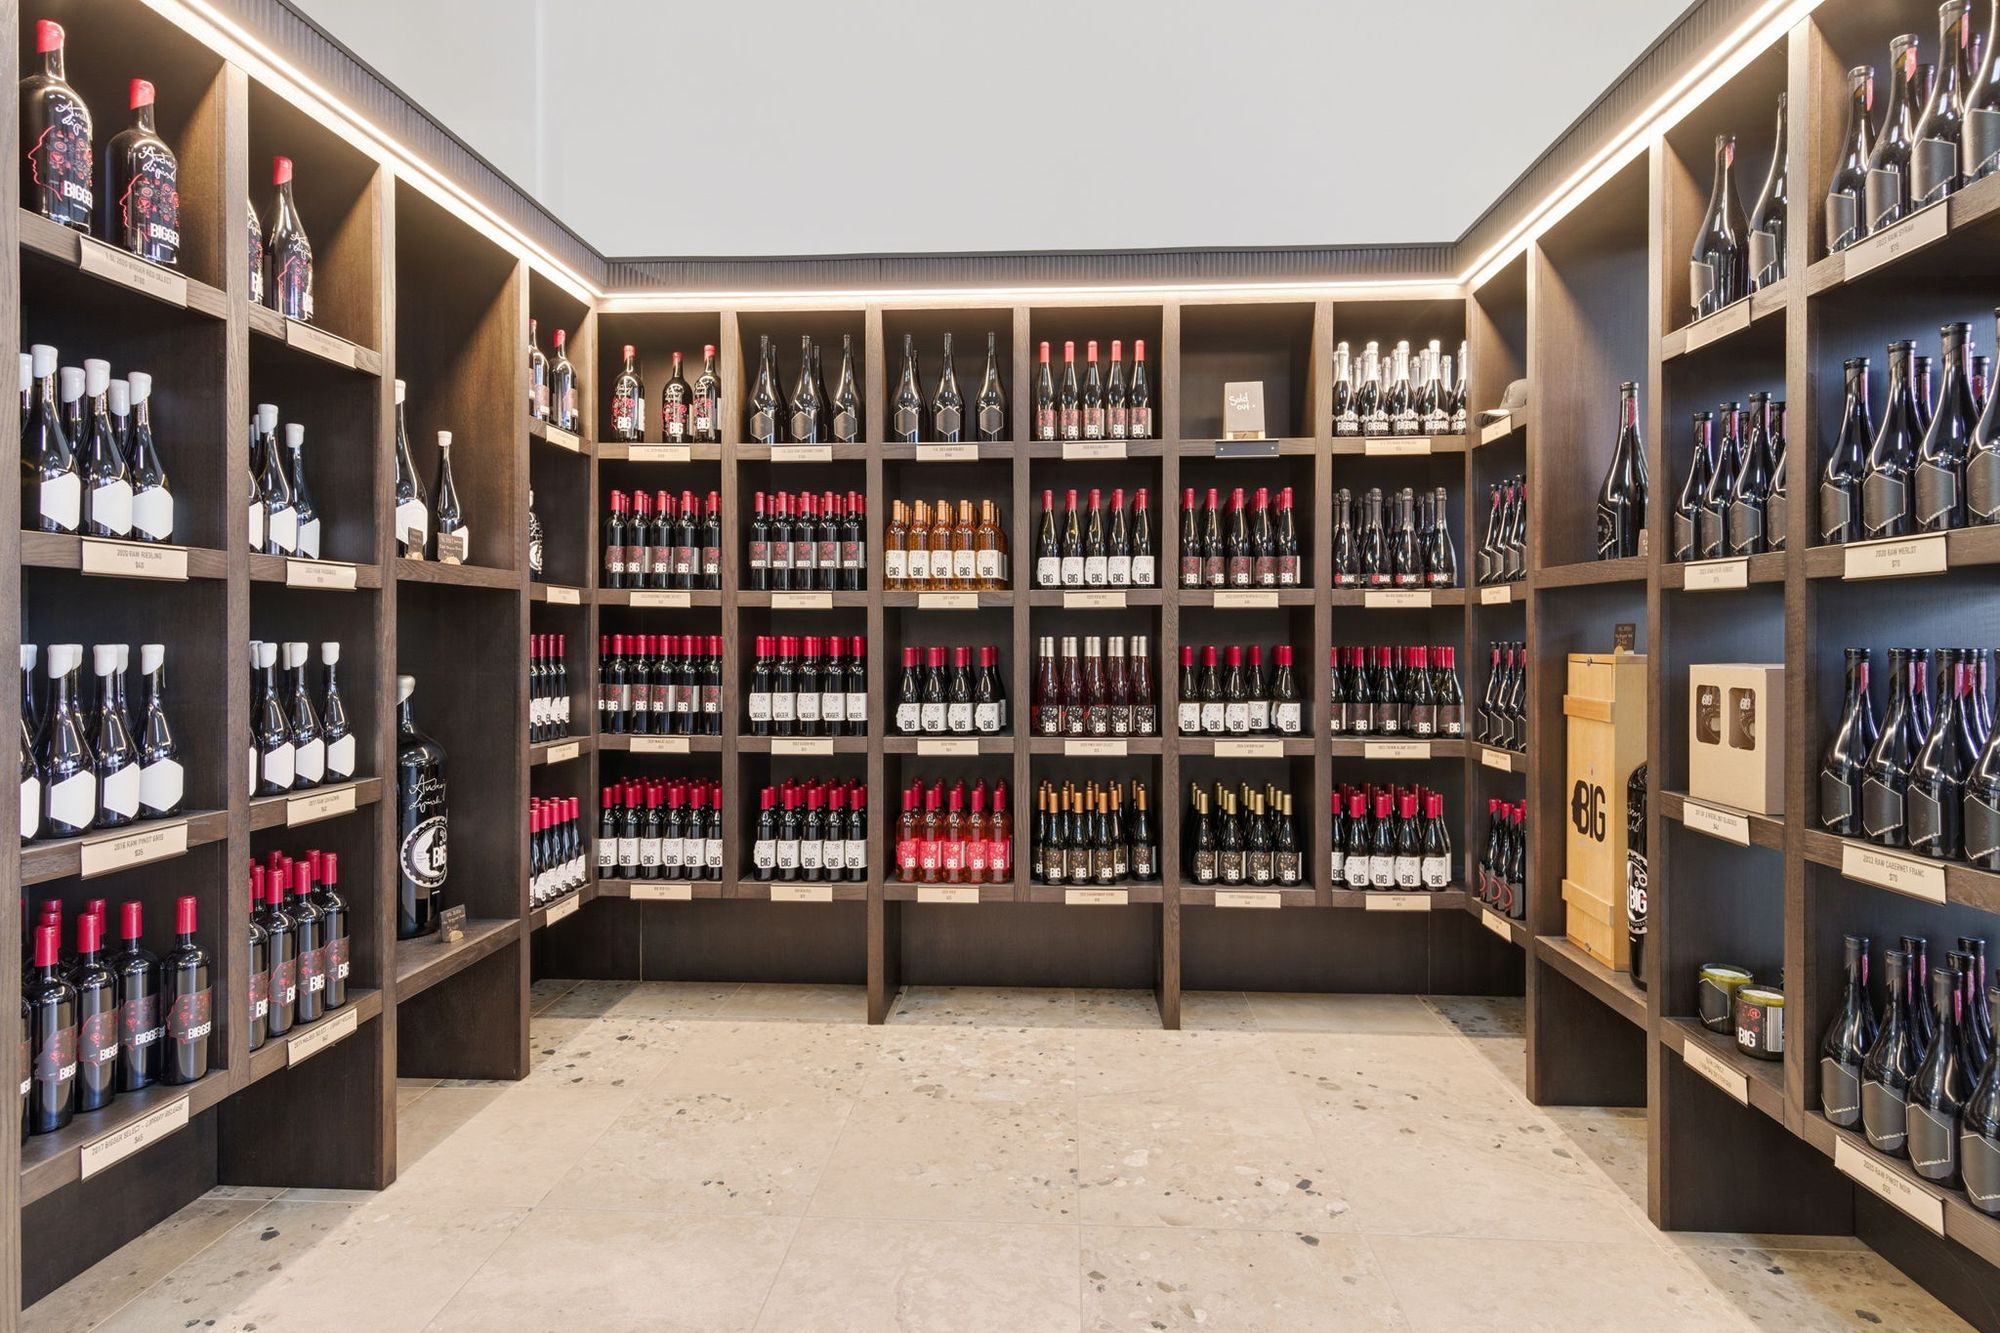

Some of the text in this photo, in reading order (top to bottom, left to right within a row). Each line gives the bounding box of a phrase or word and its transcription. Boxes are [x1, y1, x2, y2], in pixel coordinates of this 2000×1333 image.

[1229, 392, 1248, 406] Sold
[617, 417, 631, 429] BIG
[670, 422, 683, 434] BIG
[697, 417, 709, 429] BIG
[1044, 427, 1054, 436] BIG
[1068, 426, 1078, 436] BIG
[1088, 425, 1098, 435] BIG
[1113, 425, 1124, 435] BIG
[1133, 424, 1143, 434] BIG
[613, 563, 623, 572] BIG
[629, 563, 640, 572] BIG
[656, 563, 666, 572] BIG
[678, 563, 688, 572] BIG
[707, 564, 717, 573] BIG
[889, 567, 899, 576] BIG
[913, 567, 923, 576] BIG
[937, 567, 946, 576] BIG
[960, 567, 970, 576] BIG
[983, 567, 993, 576] BIG
[1043, 574, 1053, 583] BIG
[1068, 574, 1078, 583] BIG
[1092, 573, 1102, 582] BIG
[1113, 573, 1123, 582] BIG
[1139, 573, 1150, 582] BIG
[1186, 574, 1197, 583] BIG
[1215, 574, 1224, 583] BIG
[1237, 573, 1248, 583] BIG
[1264, 573, 1274, 584] BIG
[1281, 573, 1292, 582] BIG
[608, 701, 617, 710] BIG
[636, 700, 647, 710] BIG
[654, 702, 663, 711] BIG
[678, 702, 688, 711] BIG
[706, 702, 716, 711] BIG
[905, 720, 915, 729] BIG
[928, 720, 938, 729] BIG
[955, 720, 965, 729] BIG
[983, 720, 993, 729] BIG
[1046, 722, 1056, 732] BIG
[1072, 722, 1082, 732] BIG
[1096, 722, 1106, 732] BIG
[1116, 722, 1126, 732] BIG
[1142, 722, 1152, 732] BIG
[1184, 720, 1194, 730] BIG
[1210, 720, 1220, 730] BIG
[1233, 720, 1243, 730] BIG
[1251, 718, 1262, 727] BIG
[1286, 720, 1296, 730] BIG
[1356, 720, 1367, 730] BIG
[1386, 720, 1396, 730] BIG
[1419, 722, 1430, 732] BIG
[1450, 723, 1460, 732] BIG
[1572, 780, 1606, 842] BIG
[600, 855, 611, 865] BIG
[621, 855, 630, 864] BIG
[644, 855, 654, 864] BIG
[666, 855, 676, 865] BIG
[686, 856, 696, 865] BIG
[710, 856, 721, 865] BIG
[760, 857, 771, 866] BIG
[781, 857, 791, 867] BIG
[805, 857, 815, 867] BIG
[828, 857, 838, 866] BIG
[848, 857, 859, 866] BIG
[905, 857, 915, 867] BIG
[924, 858, 934, 868] BIG
[947, 858, 957, 868] BIG
[973, 859, 983, 868] BIG
[994, 859, 1004, 868] BIG
[1050, 868, 1061, 878] BIG
[1076, 868, 1086, 878] BIG
[1102, 868, 1112, 878] BIG
[1116, 863, 1125, 873] BIG
[1139, 863, 1149, 874] BIG
[1886, 860, 1908, 874] CABERNET
[1909, 866, 1925, 878] FRANC
[1201, 869, 1213, 879] BIG
[1228, 869, 1239, 879] BIG
[1258, 870, 1269, 879] BIG
[1284, 870, 1295, 880] BIG
[1333, 869, 1343, 878] BIG
[1353, 874, 1364, 884] BIG
[1376, 874, 1387, 884] BIG
[1402, 874, 1413, 884] BIG
[1431, 874, 1442, 884] BIG
[1630, 885, 1648, 914] BIG
[1738, 1027, 1756, 1048] BIG
[123, 1124, 140, 1140] SELECT
